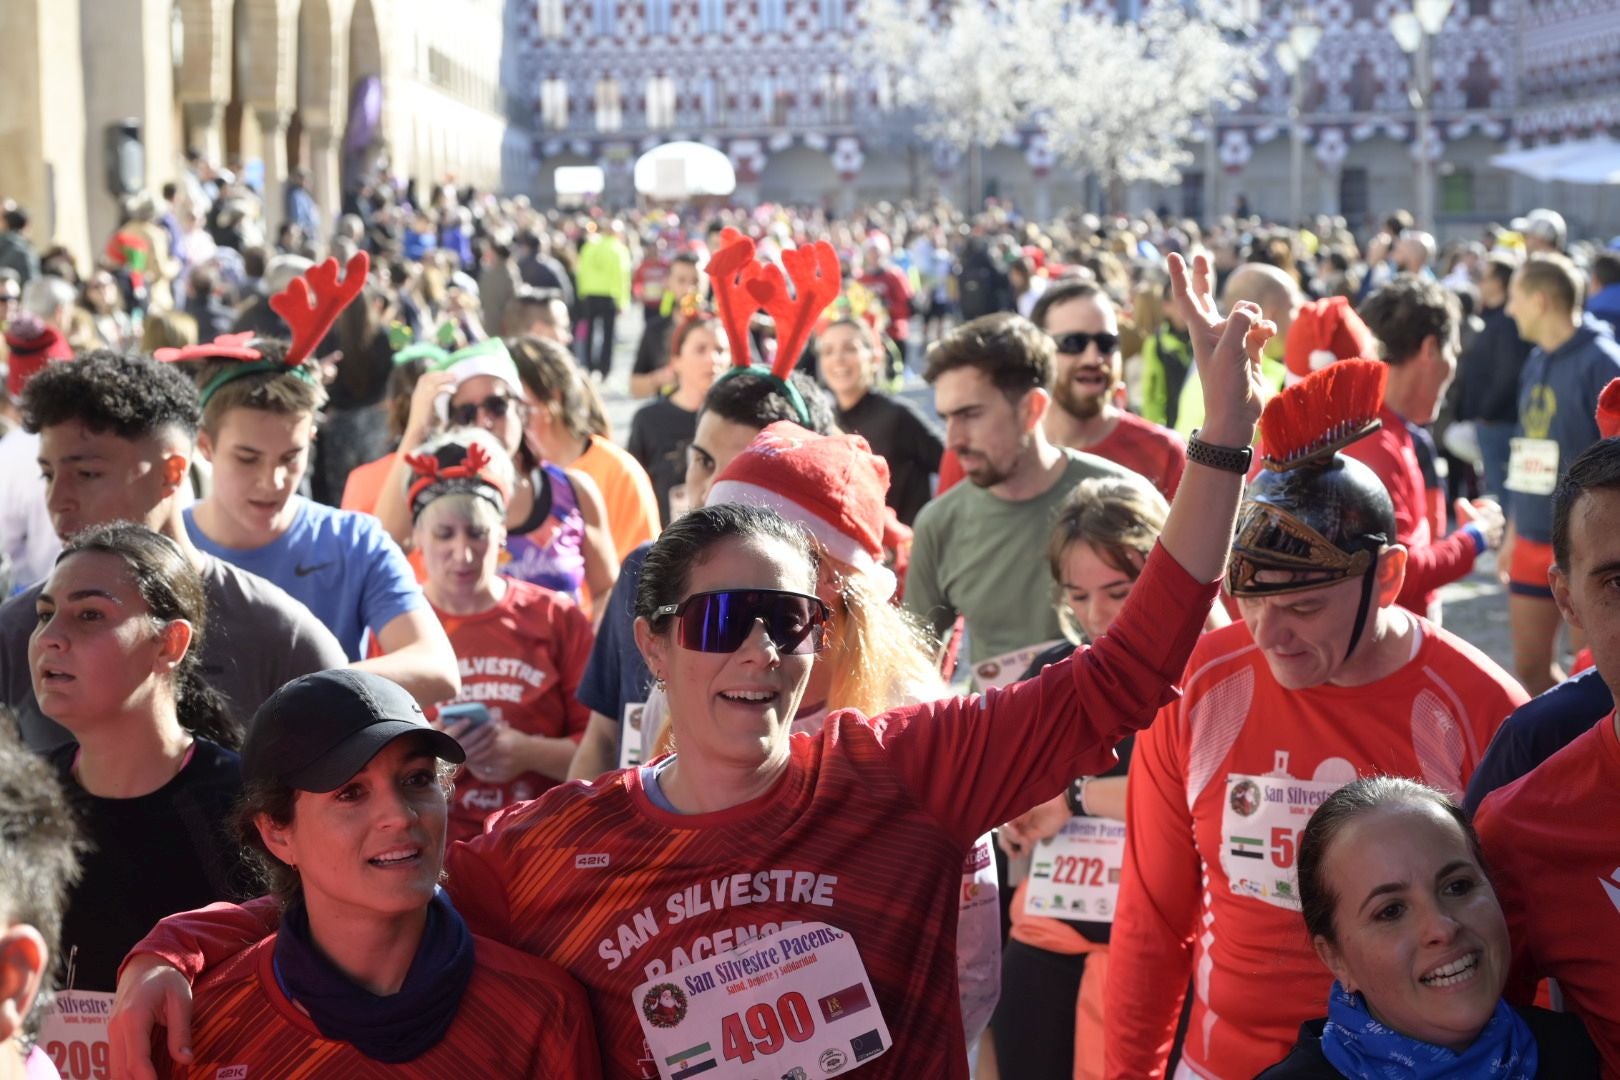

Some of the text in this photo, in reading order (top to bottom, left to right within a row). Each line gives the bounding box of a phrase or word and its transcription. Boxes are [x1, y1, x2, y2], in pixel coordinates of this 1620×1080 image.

[457, 656, 546, 688] ILVESTRE
[455, 681, 524, 703] CENSE
[1264, 785, 1284, 803] San
[577, 854, 607, 867] 42K
[1271, 827, 1305, 868] 5
[1052, 856, 1104, 887] 2272
[598, 869, 838, 970] SAN SILVESTRE
[644, 921, 803, 983] PACEN
[684, 970, 716, 997] San
[715, 945, 781, 985] Silvestre
[726, 981, 748, 996] Salud,
[748, 972, 774, 990] Deporte
[779, 953, 818, 976] Solidaridad
[57, 995, 109, 1014] Silvestre
[721, 991, 815, 1065] 490
[218, 1067, 244, 1079] 42K
